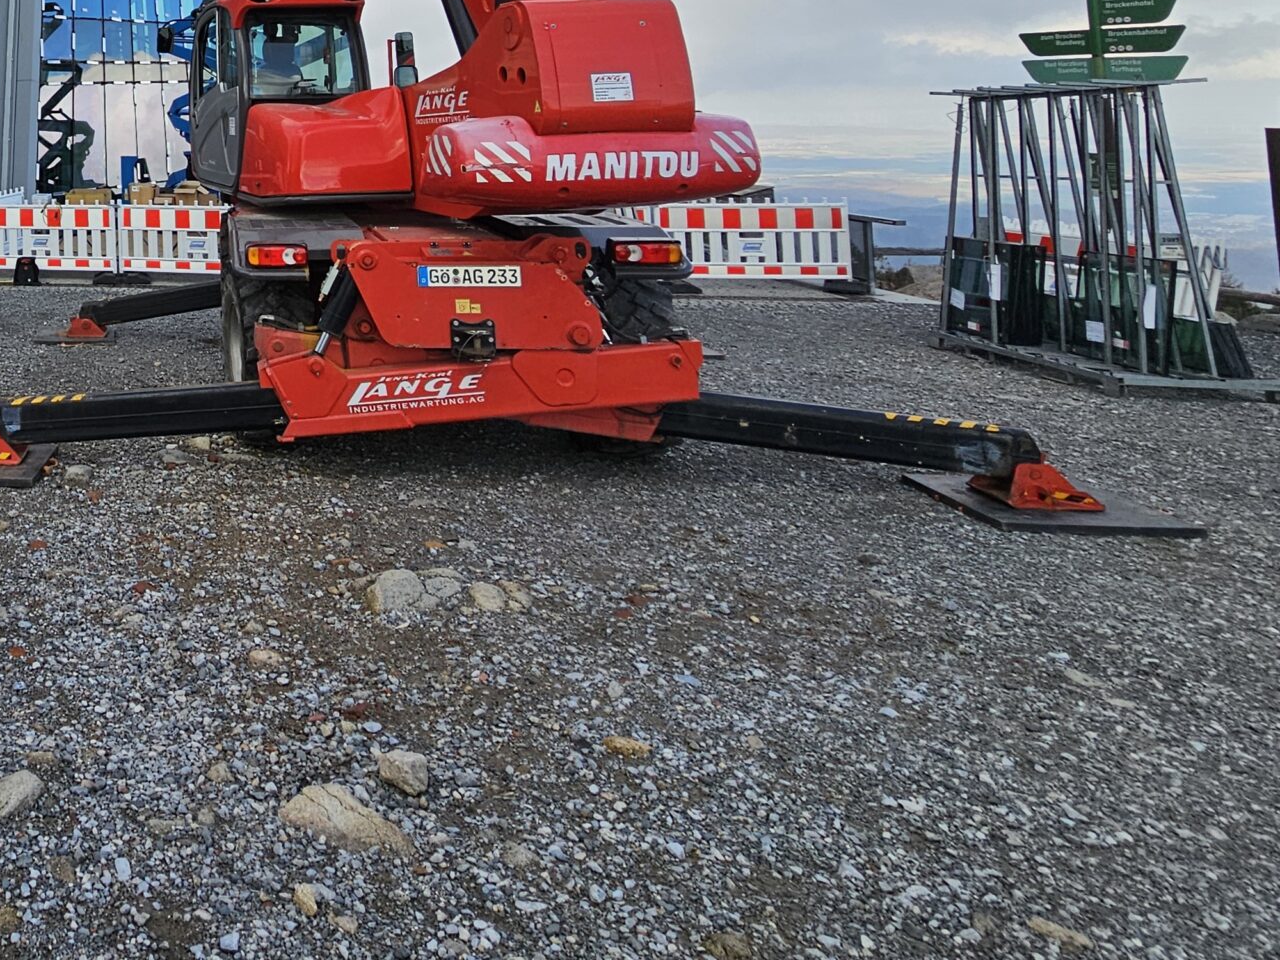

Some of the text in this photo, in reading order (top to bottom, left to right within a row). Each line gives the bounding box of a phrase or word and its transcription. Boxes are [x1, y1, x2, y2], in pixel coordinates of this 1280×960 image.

[415, 91, 468, 118] LANGE
[545, 151, 699, 181] MANITOU
[462, 269, 484, 284] AG
[487, 269, 518, 284] 233
[347, 374, 482, 406] LANGE
